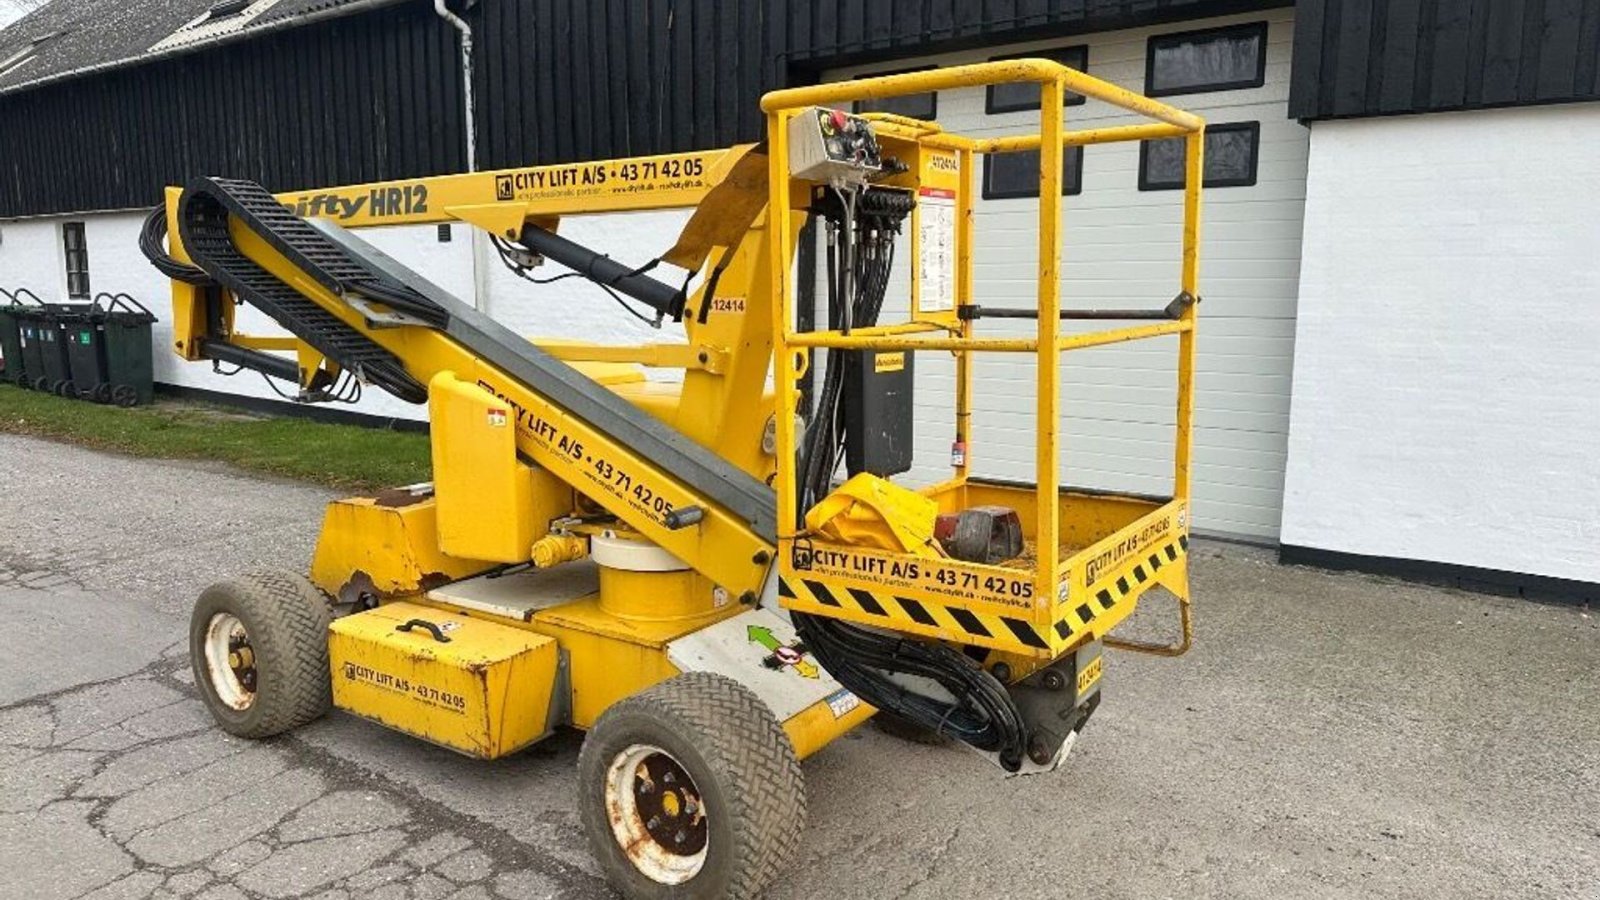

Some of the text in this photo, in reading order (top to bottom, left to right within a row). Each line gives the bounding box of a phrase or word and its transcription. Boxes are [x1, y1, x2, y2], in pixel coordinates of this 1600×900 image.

[516, 158, 703, 190] CITY LIFT A/S 43 71 42 05
[369, 184, 428, 217] HR12
[710, 300, 744, 312] 12414
[528, 413, 557, 441] LIFT
[558, 435, 584, 460] A/S
[595, 459, 613, 479] 43
[615, 470, 631, 491] 71
[633, 484, 652, 505] 42
[654, 497, 673, 517] 05
[1095, 550, 1112, 571] CITY
[1114, 541, 1126, 562] LIFT
[814, 550, 1032, 598] CITY LIFT A/S 43 71 42 05
[356, 665, 374, 680] CITY
[376, 671, 393, 685] LIFT
[395, 678, 410, 691] A/S
[417, 685, 428, 697] 43
[430, 688, 438, 700] 71
[441, 692, 452, 705] 42
[453, 696, 465, 708] 05
